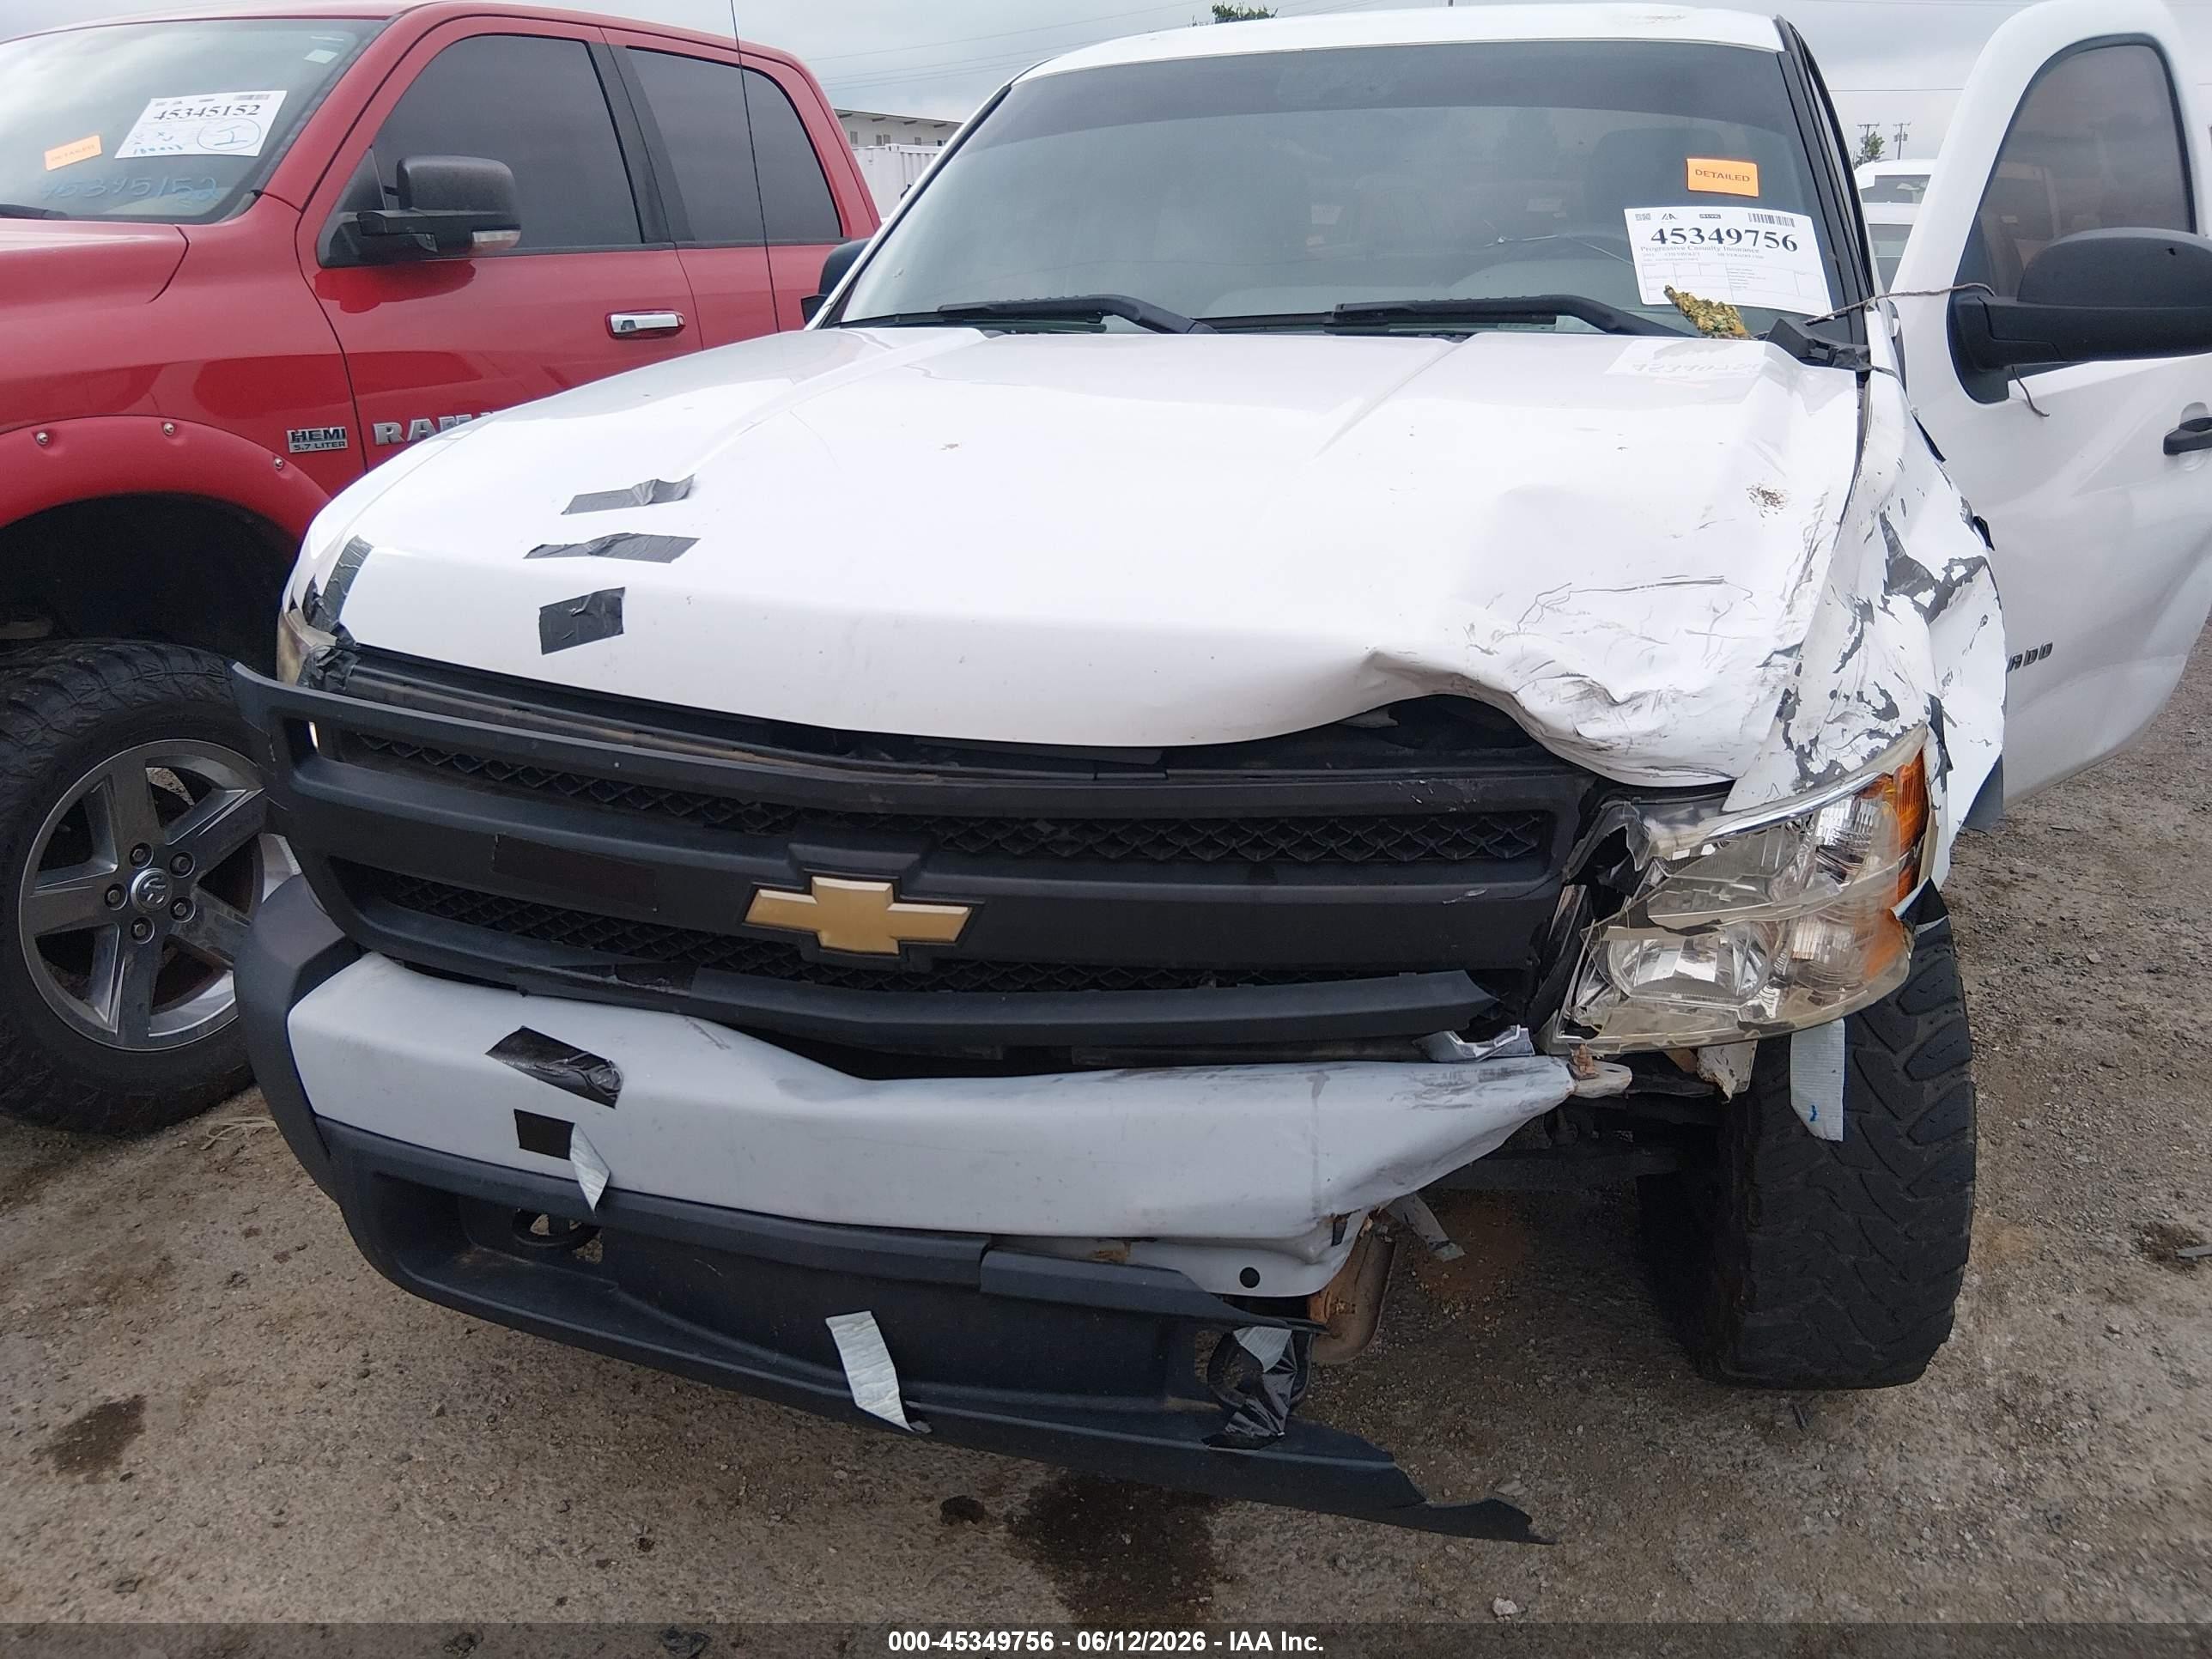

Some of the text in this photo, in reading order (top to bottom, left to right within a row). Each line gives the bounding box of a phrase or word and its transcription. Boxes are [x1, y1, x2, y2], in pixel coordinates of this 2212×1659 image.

[154, 104, 261, 120] 45345152
[1695, 168, 1751, 182] DETAILED
[1650, 228, 1798, 252] 45349756
[290, 428, 346, 442] HEMI
[314, 441, 346, 449] LITER
